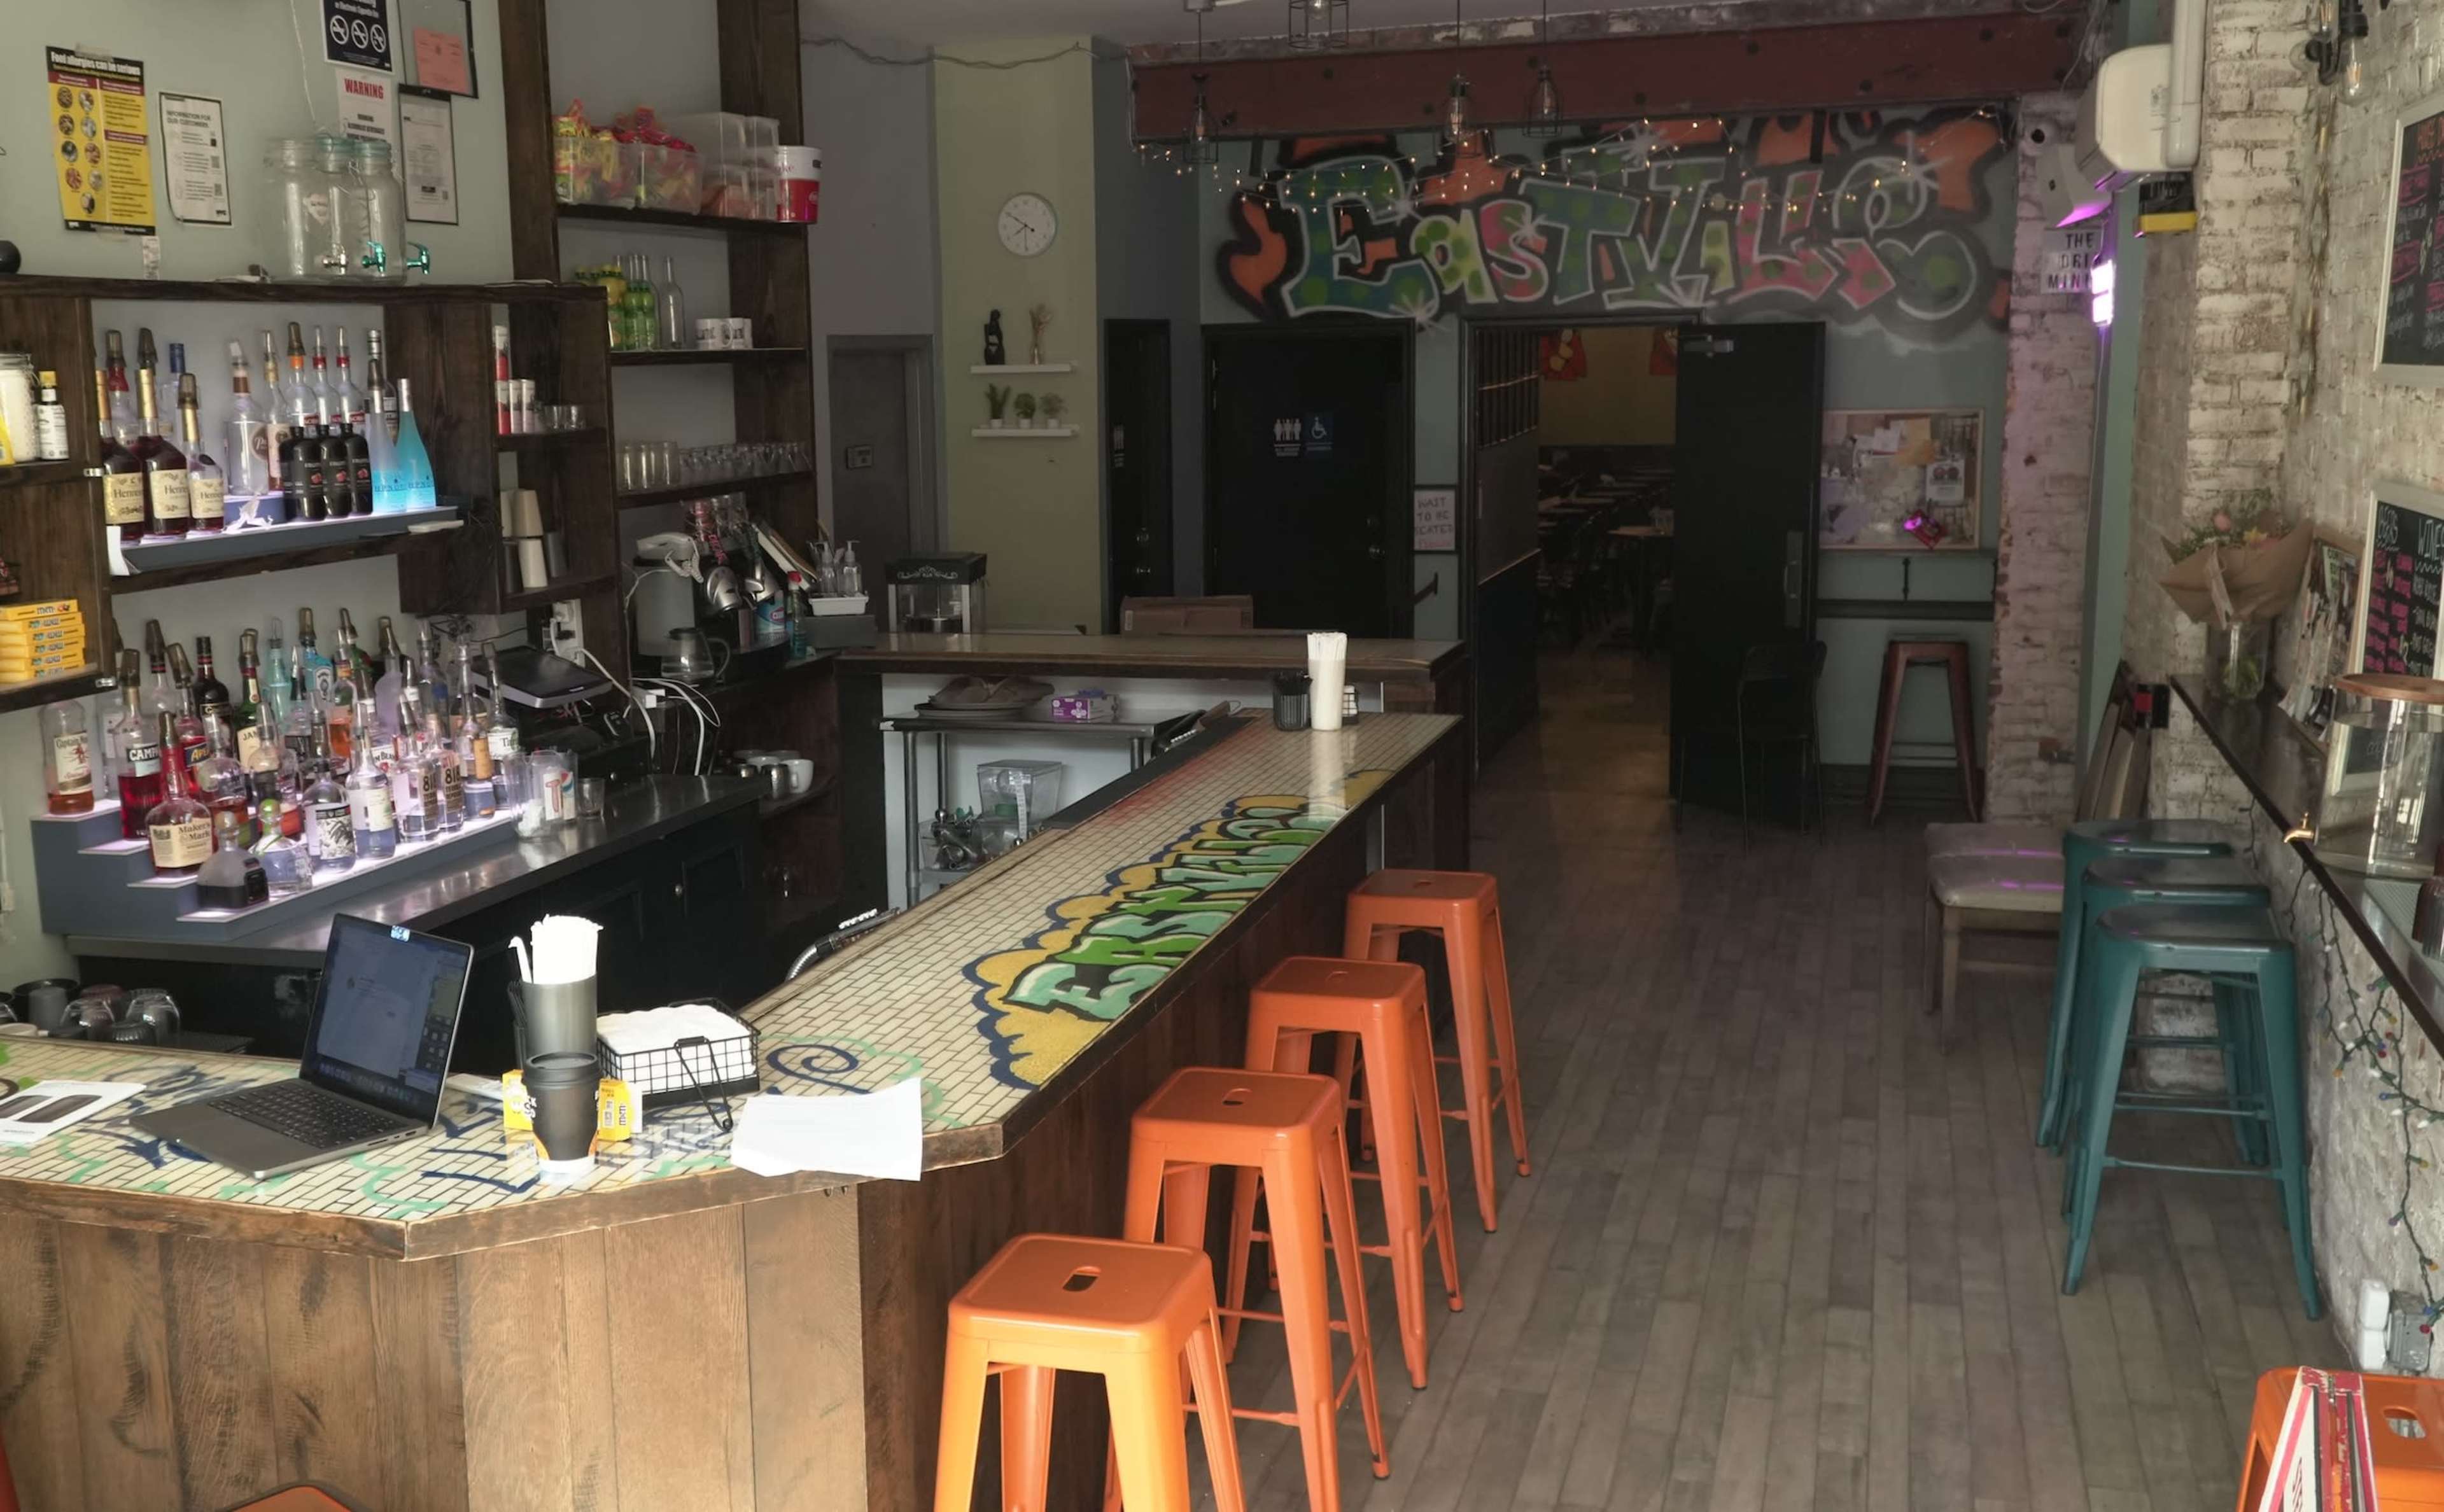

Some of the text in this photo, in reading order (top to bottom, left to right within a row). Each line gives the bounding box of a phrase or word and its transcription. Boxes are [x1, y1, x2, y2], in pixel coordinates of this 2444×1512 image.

[344, 78, 384, 99] WARNING
[2066, 232, 2094, 249] THE
[1417, 496, 1447, 508] WAIT
[1415, 509, 1452, 522] TO BE
[179, 822, 211, 834] Maker's
[189, 829, 211, 841] Mark
